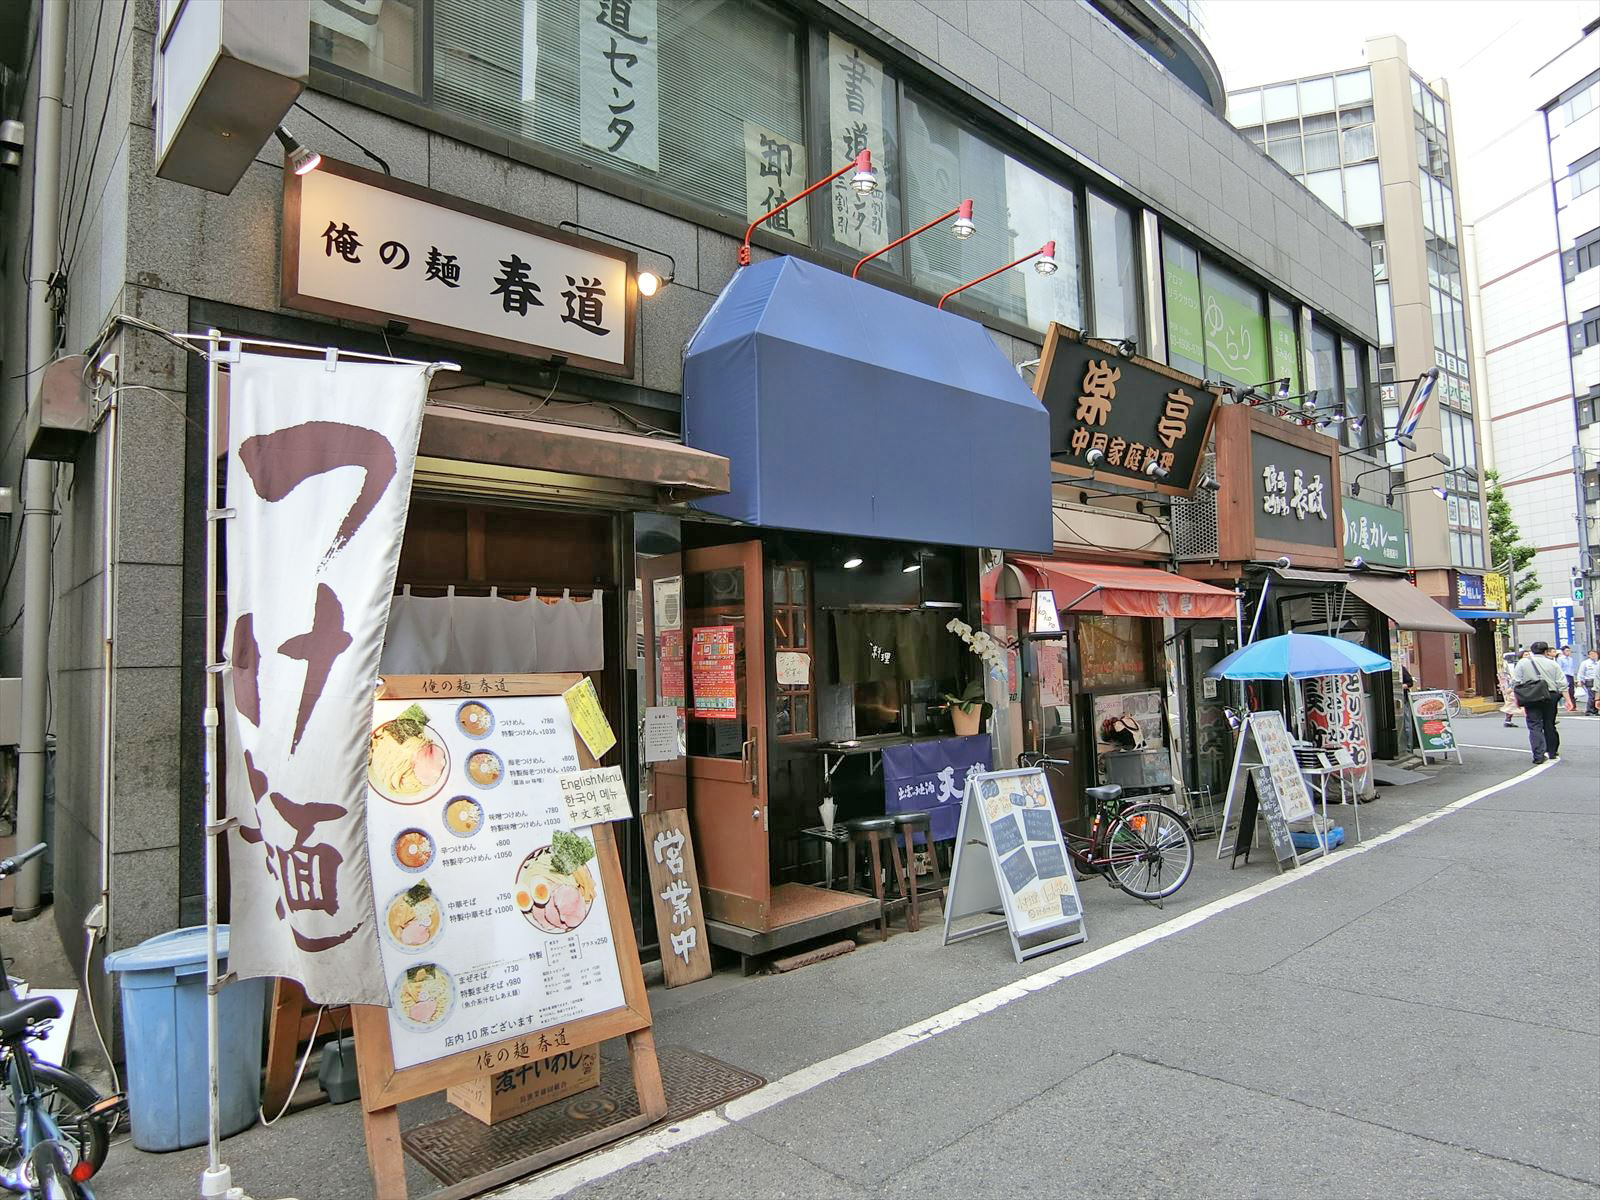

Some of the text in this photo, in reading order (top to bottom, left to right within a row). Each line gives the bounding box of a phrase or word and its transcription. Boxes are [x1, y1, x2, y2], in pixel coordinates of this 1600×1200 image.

[839, 49, 874, 246] 書道ンター
[758, 133, 795, 238] 卸値
[320, 220, 611, 336] 俺の麺 春道
[1203, 296, 1251, 361] ゆらり
[1072, 427, 1175, 472] 中国家庭料理
[1342, 507, 1399, 550] 乃屋カレー
[421, 679, 510, 694] 俺の麺 春道
[501, 729, 539, 737] 特製つけめん
[560, 772, 622, 790] English Menu
[565, 788, 618, 807] 한국어 메뉴
[448, 898, 476, 910] 中華そば
[653, 828, 697, 965] 営業中
[449, 907, 492, 924] 特製中華そば
[459, 971, 488, 985] まぜそば
[460, 980, 504, 998] 特製まぜそば
[476, 1028, 570, 1071] 俺の麺 春道
